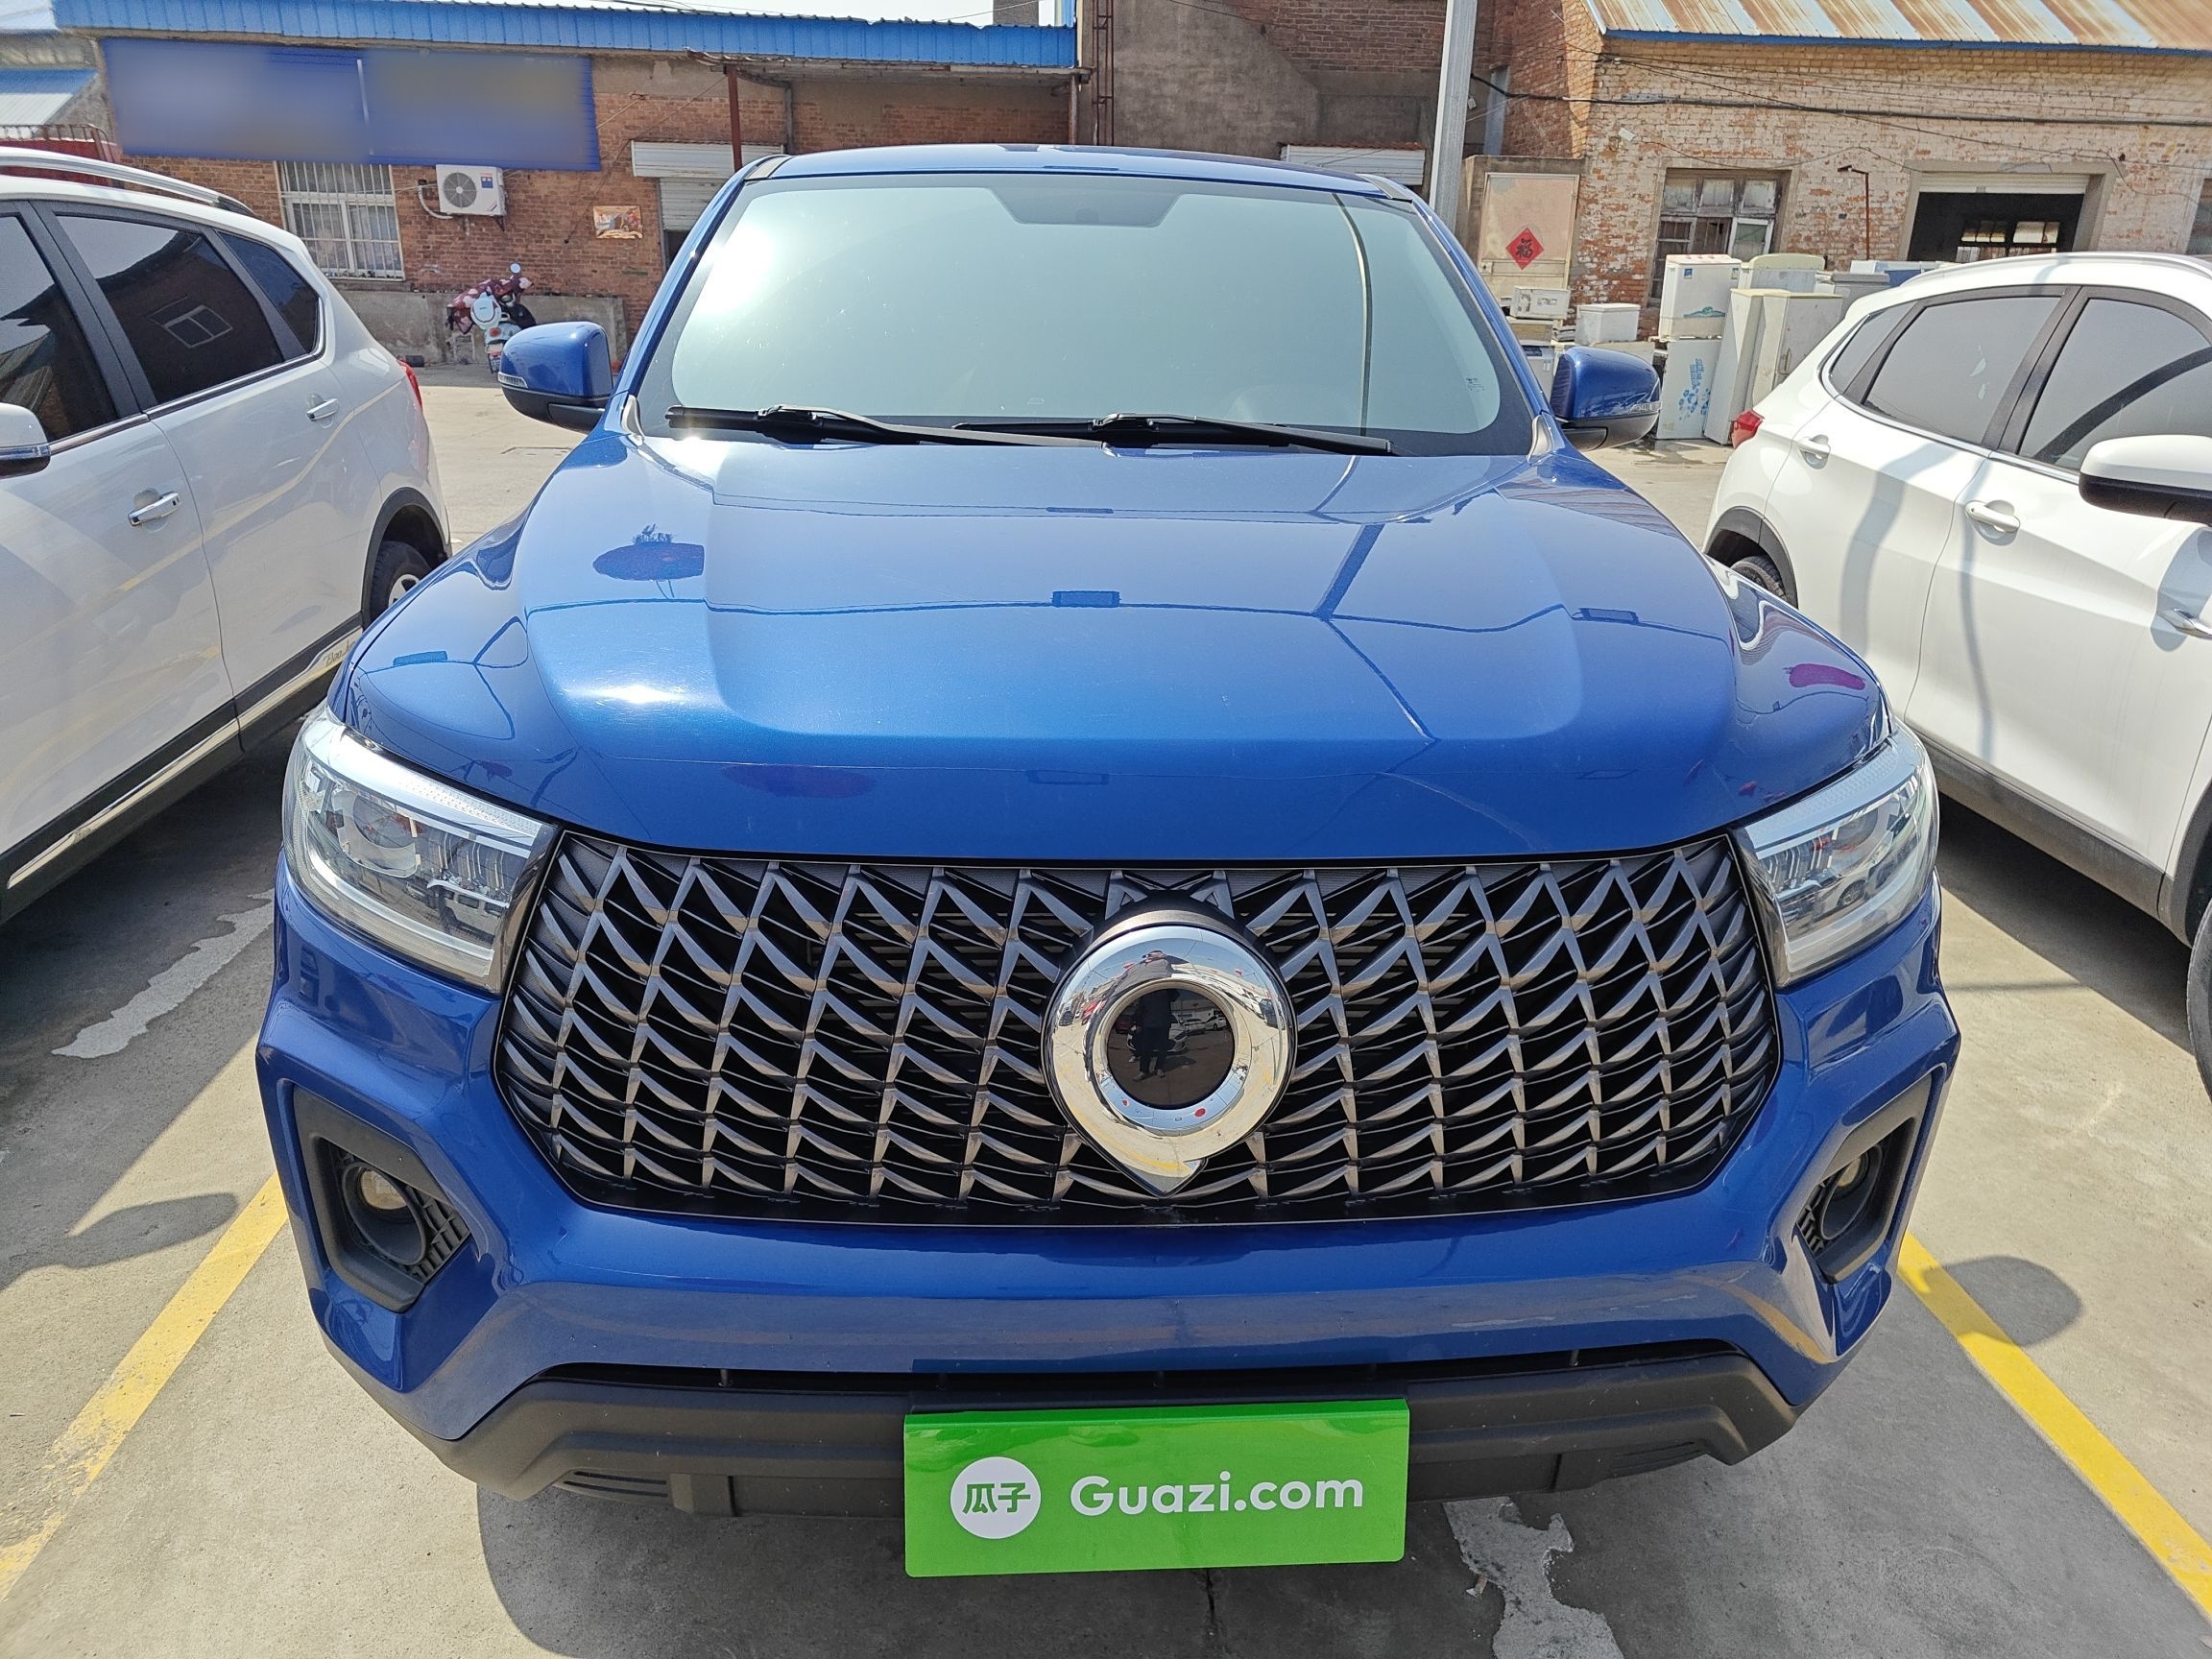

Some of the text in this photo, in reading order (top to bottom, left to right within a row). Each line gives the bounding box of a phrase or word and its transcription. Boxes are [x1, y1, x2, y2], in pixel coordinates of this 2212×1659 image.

[1515, 237, 1534, 259] 福
[962, 1481, 1031, 1514] 瓜子
[1070, 1470, 1364, 1517] Guazi.com
